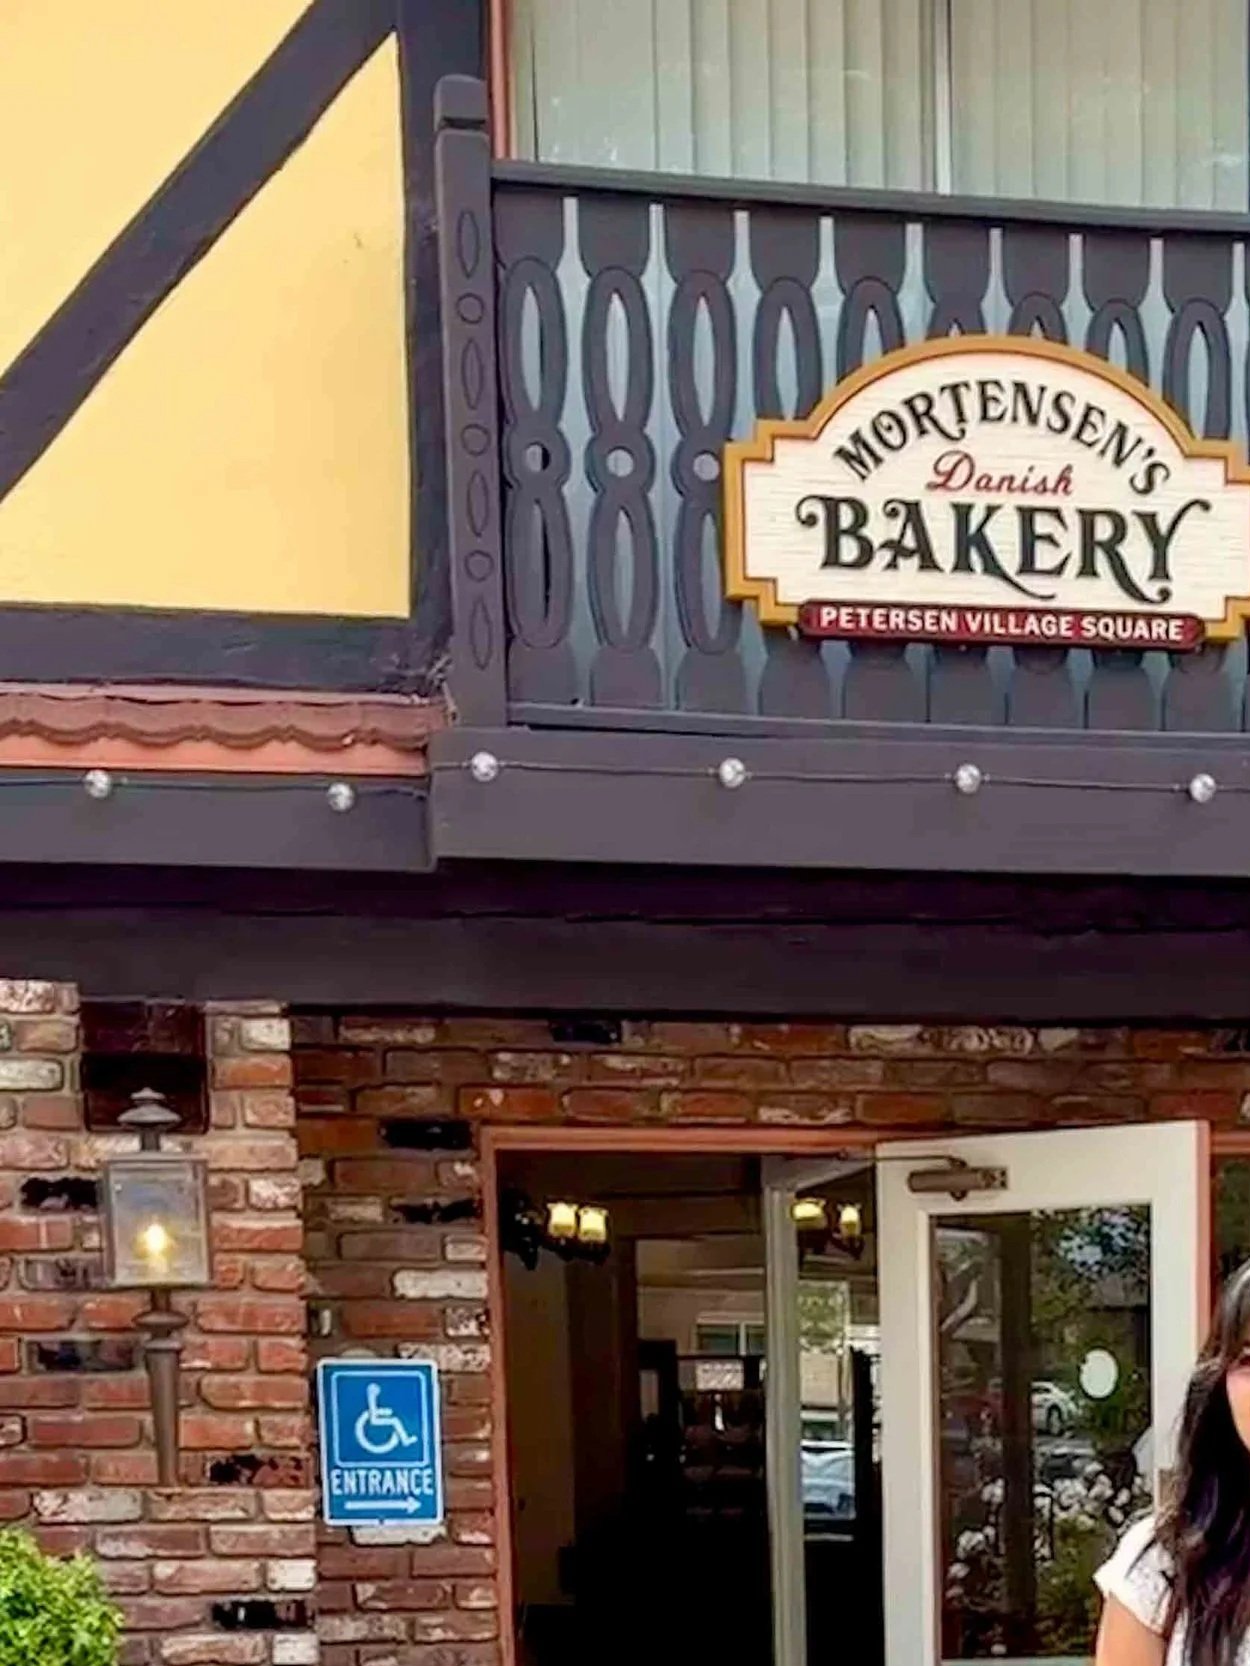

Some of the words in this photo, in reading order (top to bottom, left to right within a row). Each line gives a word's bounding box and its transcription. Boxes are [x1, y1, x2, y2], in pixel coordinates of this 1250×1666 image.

[832, 379, 1171, 497] MORTENSEN'S
[926, 449, 1074, 496] Danish
[795, 493, 1211, 604] BAKERY
[820, 607, 959, 633] PETERSEN
[965, 612, 1074, 638] VILLAGE
[1079, 617, 1184, 641] SQUARE
[330, 1468, 434, 1496] ENTRANCE
